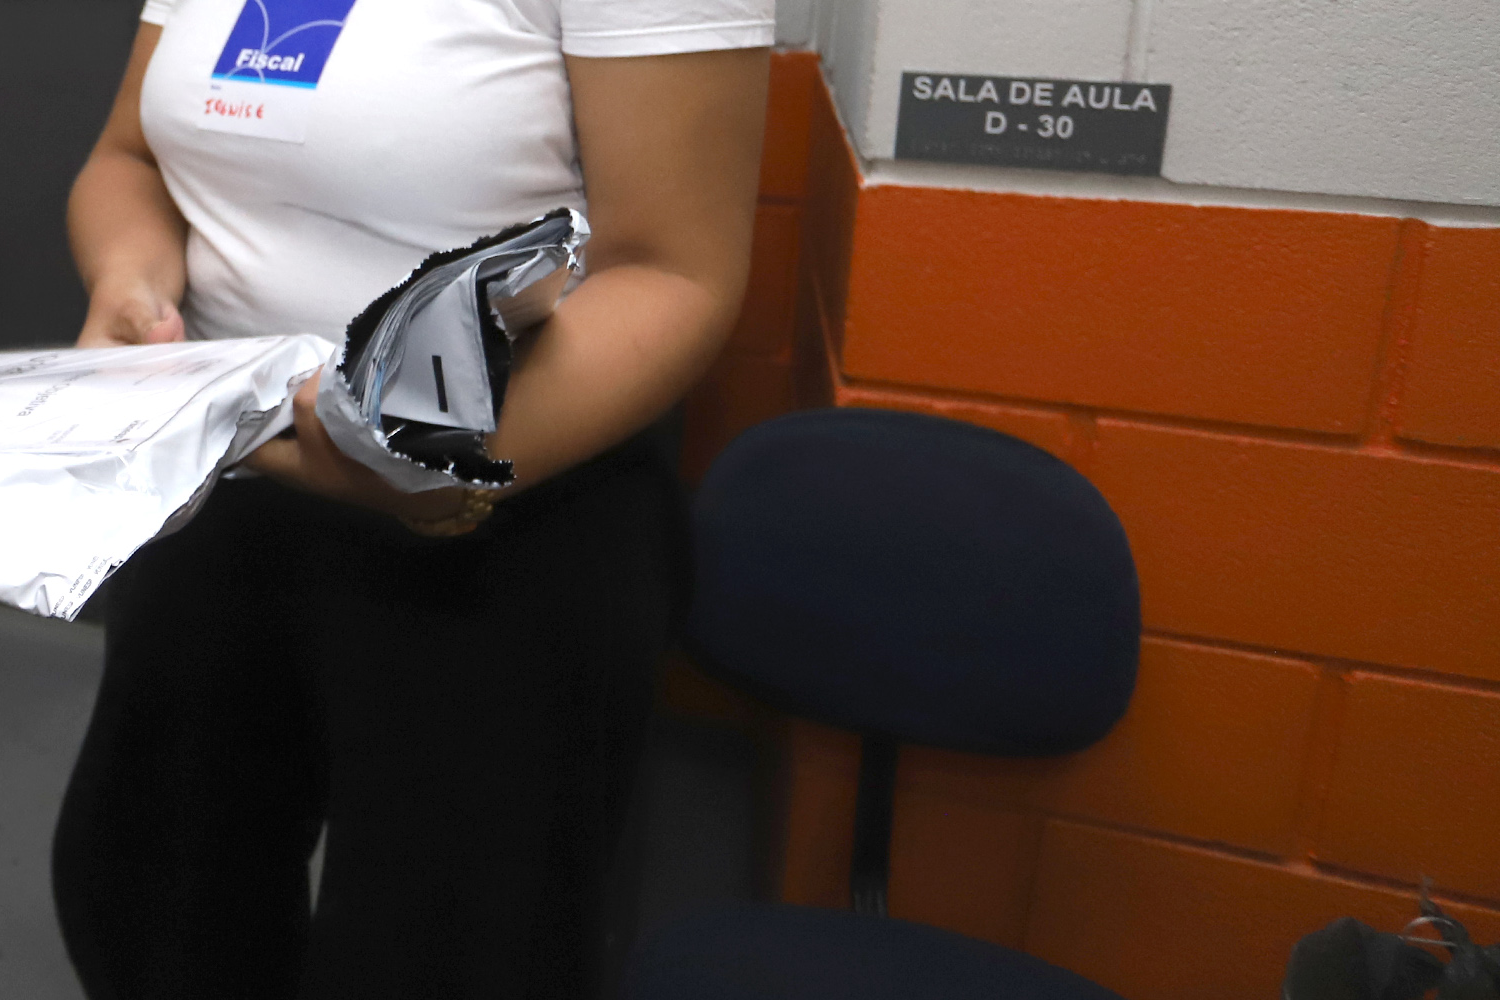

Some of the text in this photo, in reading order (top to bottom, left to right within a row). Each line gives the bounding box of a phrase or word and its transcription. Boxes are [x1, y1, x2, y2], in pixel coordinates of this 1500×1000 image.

[236, 48, 306, 73] Fiscal
[913, 75, 1157, 112] SALA DE AULA
[984, 111, 1006, 135] D
[1036, 115, 1074, 139] 30
